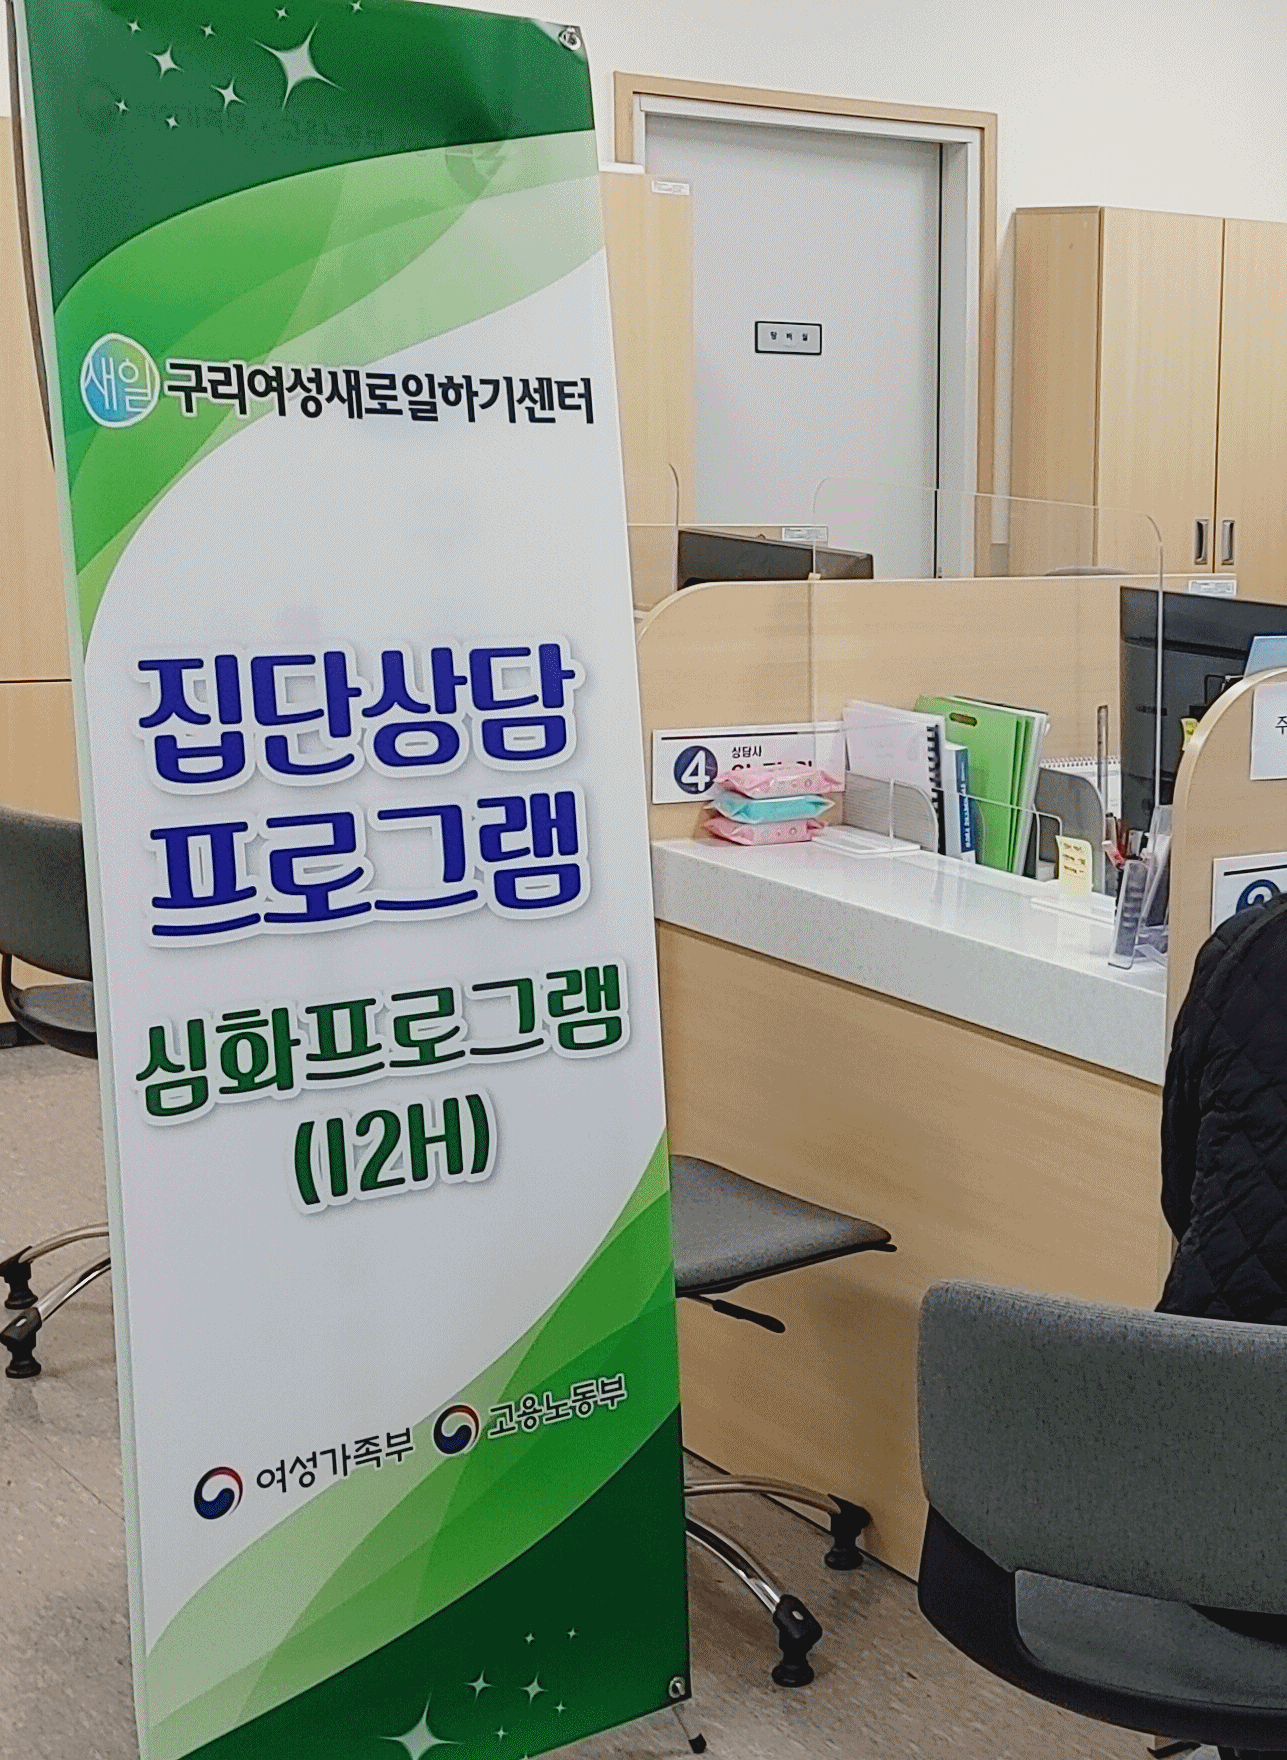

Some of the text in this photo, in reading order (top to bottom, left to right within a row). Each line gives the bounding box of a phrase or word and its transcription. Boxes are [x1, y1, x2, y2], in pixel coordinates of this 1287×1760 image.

[83, 356, 594, 424] 새일 구리여성새로일하기센터
[137, 643, 576, 784] 집단상담
[681, 750, 711, 792] 4
[731, 745, 762, 758] 상담사
[150, 790, 582, 936] 프로그램
[136, 964, 623, 1117] 심화프로그램
[294, 1093, 490, 1206] (12H)
[256, 1375, 627, 1493] 여성가족부 고용노동부
